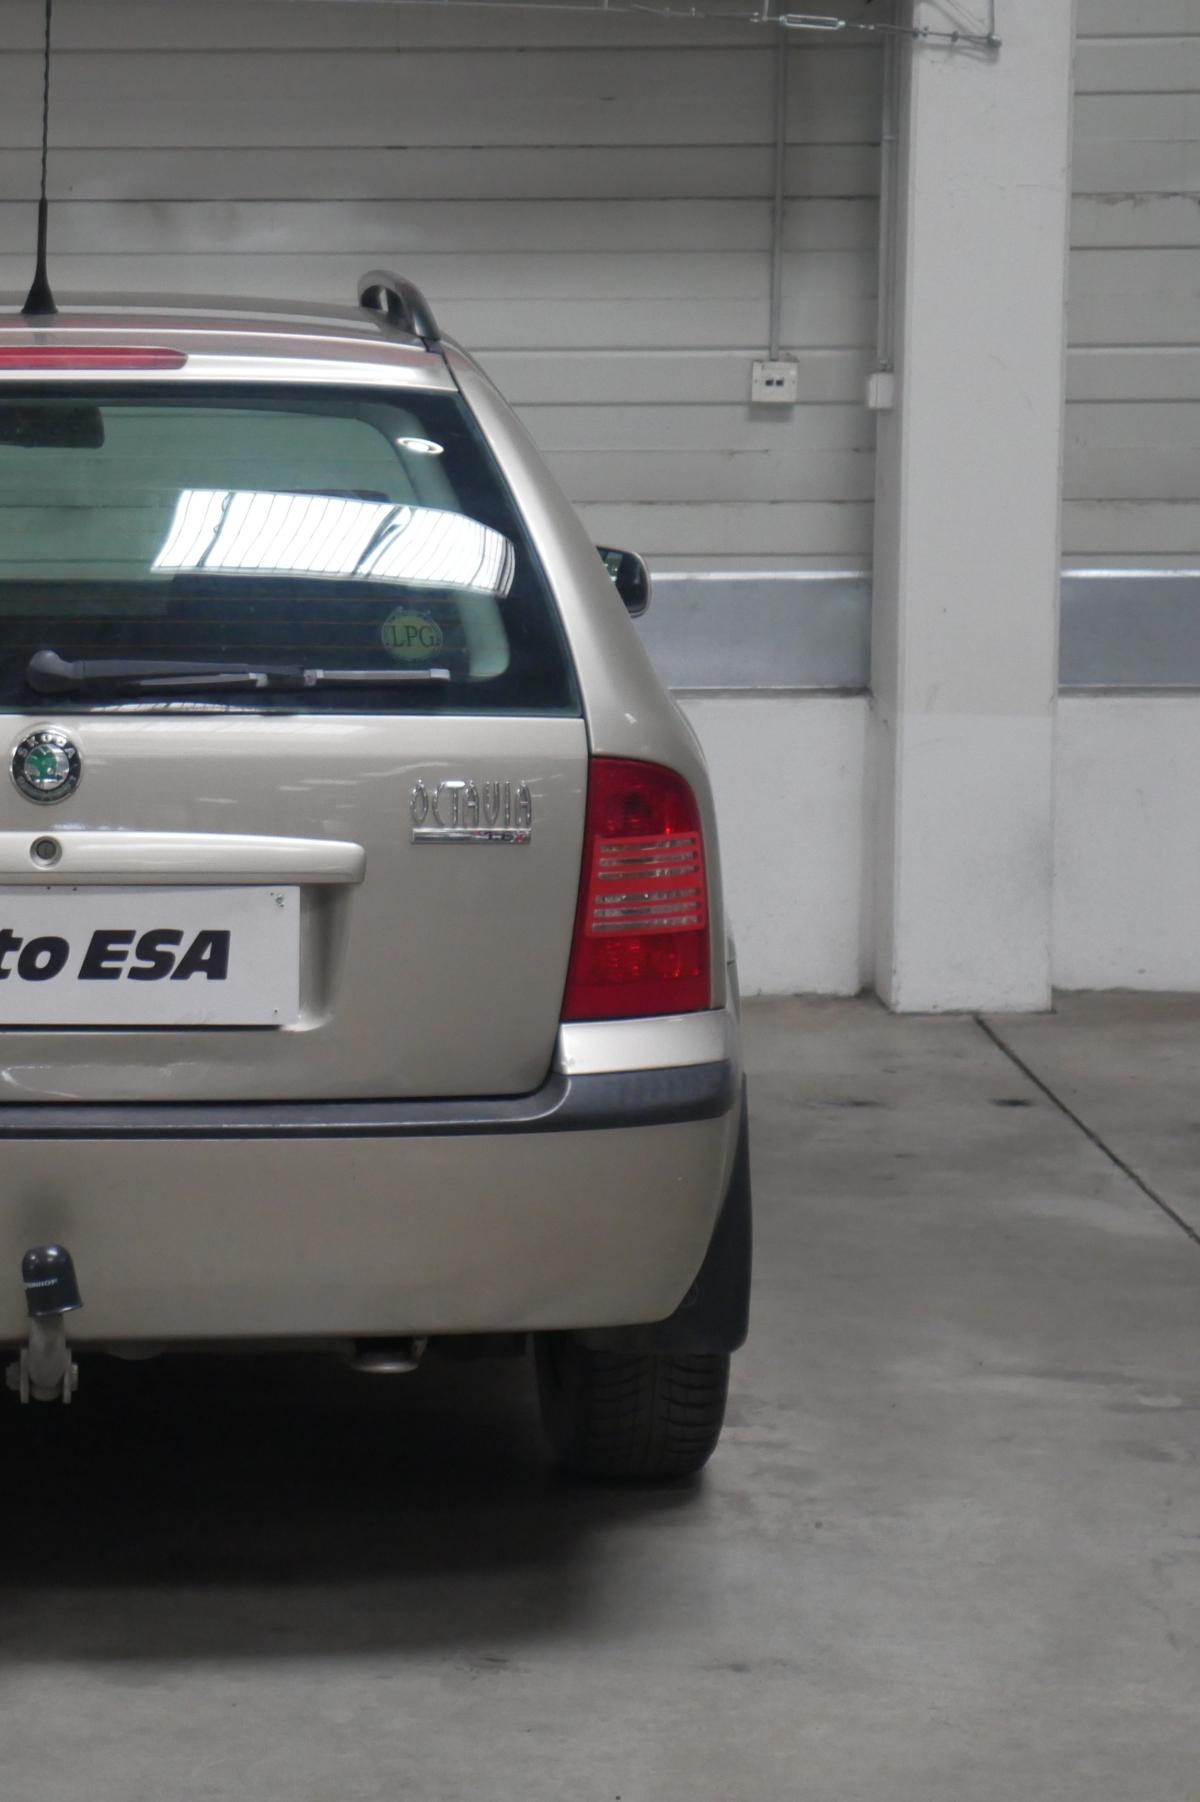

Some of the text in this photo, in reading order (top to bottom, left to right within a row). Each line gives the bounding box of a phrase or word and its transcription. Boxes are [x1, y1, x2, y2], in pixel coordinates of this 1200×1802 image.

[391, 624, 435, 648] LPG
[409, 778, 532, 827] OCTAVIA
[77, 928, 231, 980] ESA
